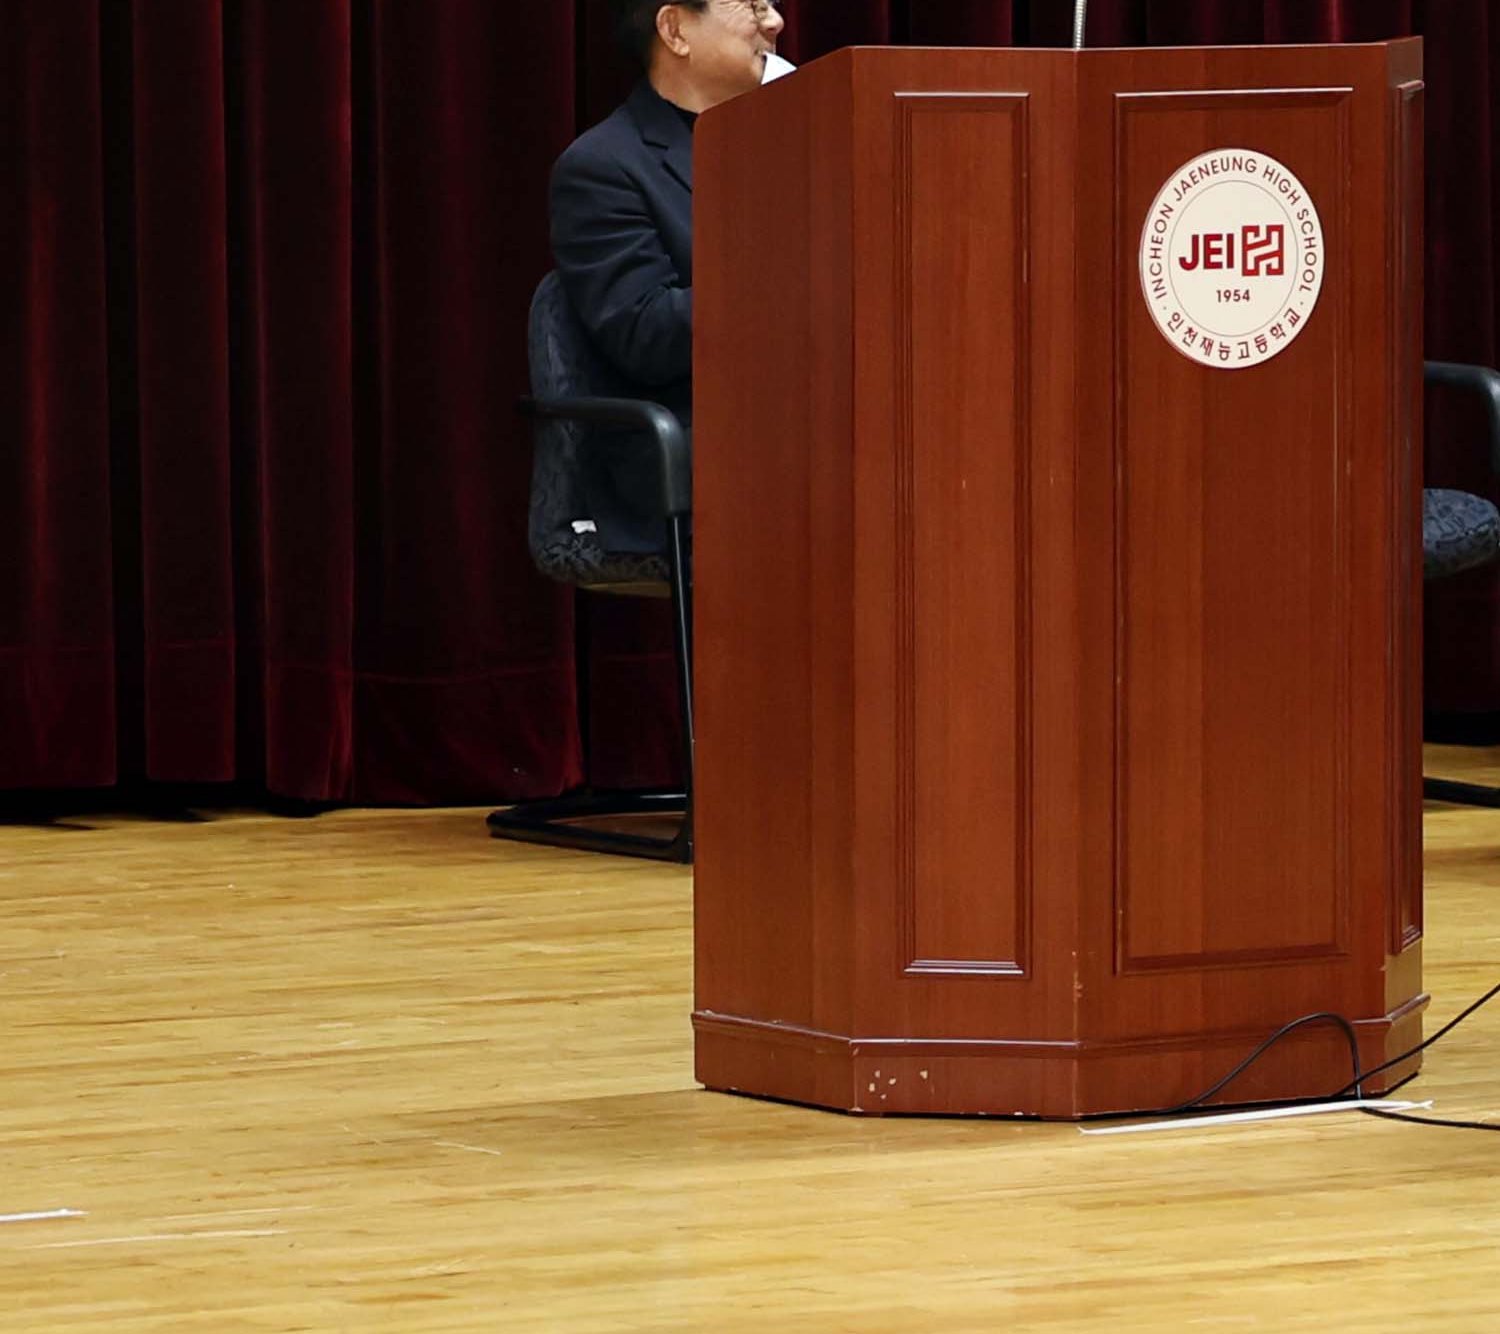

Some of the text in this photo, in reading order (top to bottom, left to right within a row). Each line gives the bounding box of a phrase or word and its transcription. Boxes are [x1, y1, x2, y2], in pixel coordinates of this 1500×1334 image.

[1149, 156, 1318, 300] INCHEON JAENEUNG HIGH SCHOOL
[1216, 289, 1251, 303] 1954
[1166, 307, 1302, 361] 인천재능고등학교
